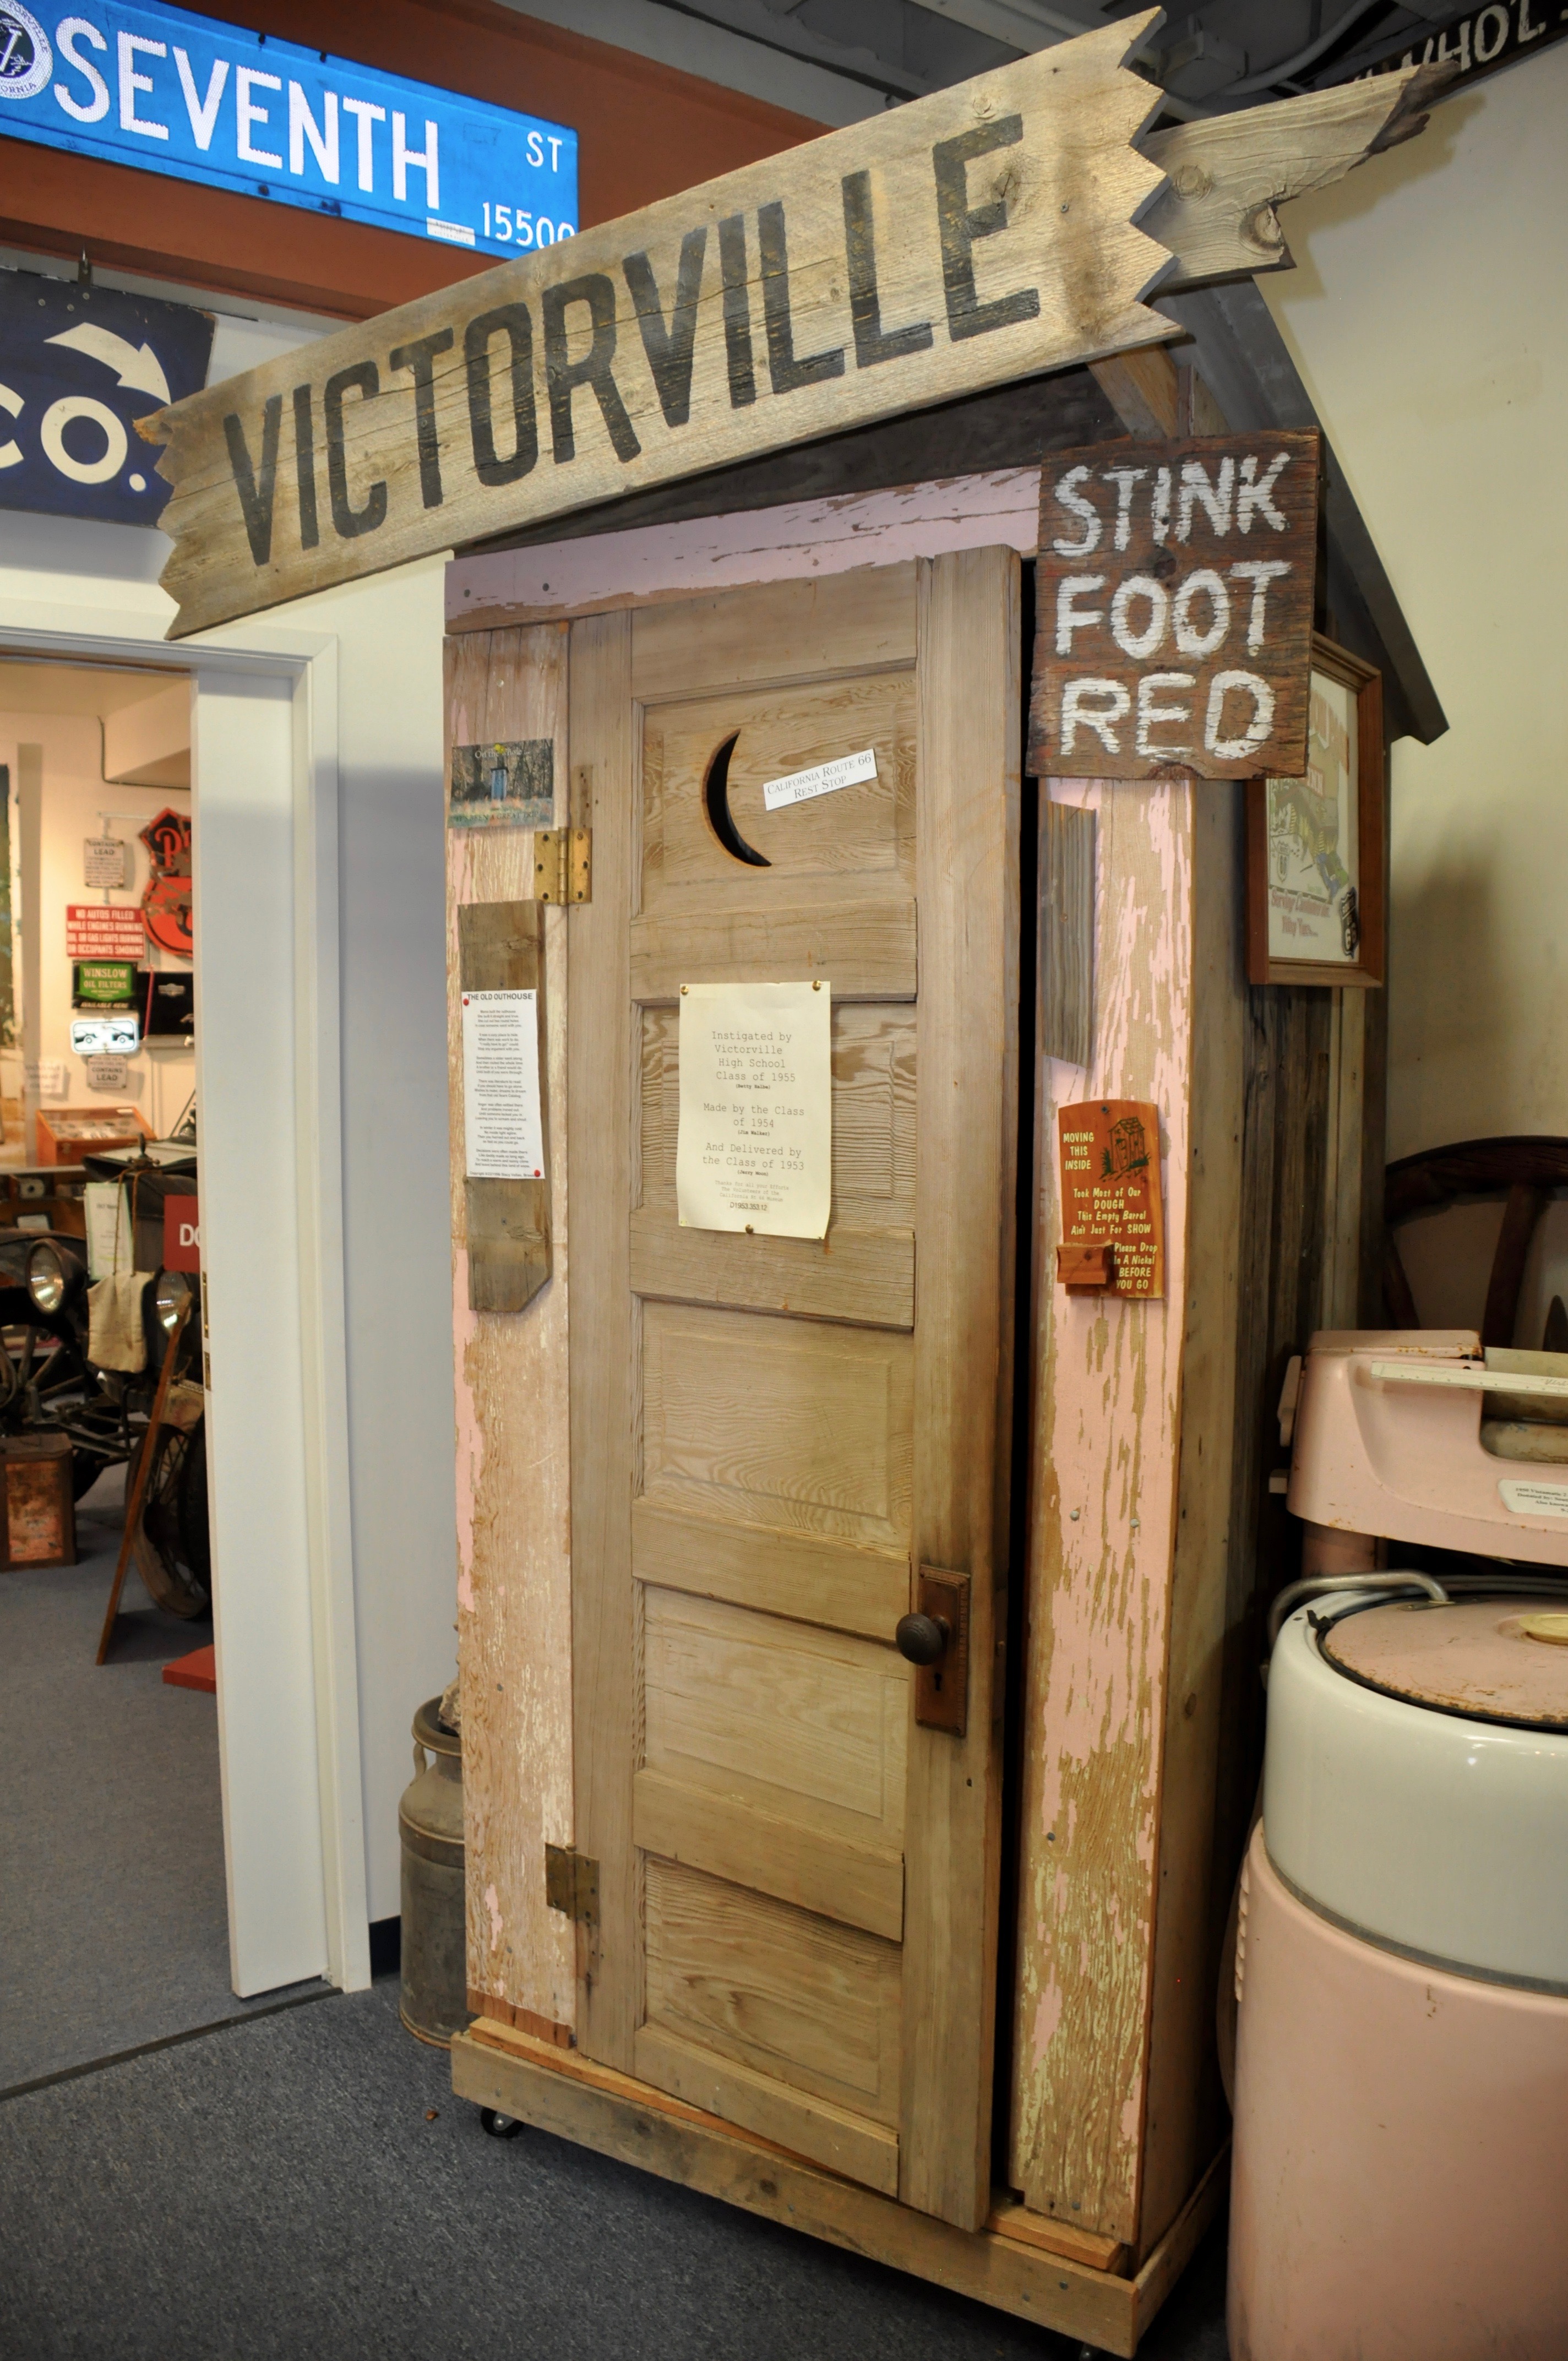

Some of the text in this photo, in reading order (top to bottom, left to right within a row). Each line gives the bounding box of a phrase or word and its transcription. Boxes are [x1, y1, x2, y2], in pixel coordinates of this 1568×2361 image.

[54, 17, 439, 210] SEVENTH
[526, 130, 563, 174] ST
[222, 114, 1041, 566] VICTORVILLE
[1053, 451, 1291, 557] STINK
[1056, 559, 1292, 659] FOOT
[1060, 670, 1275, 759] RED
[488, 749, 498, 757] the
[767, 753, 872, 795] CALIFORNIA ROUTE 66
[794, 775, 846, 798] REST STOP
[75, 909, 134, 920] NO AUTOS FILLED
[84, 968, 127, 978] WINSLOW
[712, 1031, 792, 1043] Instigated by
[715, 1045, 782, 1054] Victorville
[718, 1058, 786, 1068] High School
[716, 1071, 796, 1082] Class of 1955
[704, 1103, 804, 1116] Made by the Class
[733, 1118, 774, 1128] of 1954
[1063, 1132, 1095, 1144] MOVING
[706, 1143, 802, 1158] And Delivered by
[1070, 1145, 1088, 1156] THIS
[703, 1156, 804, 1170] the Class of 1953
[1065, 1160, 1092, 1170] INSIDE
[1073, 1187, 1142, 1198] Took Most of Our
[1094, 1199, 1125, 1210] DOUGH
[1077, 1210, 1146, 1223] This Empty Barrel
[1091, 1224, 1106, 1234] Just
[1109, 1224, 1122, 1234] For
[1127, 1223, 1151, 1234] SHOW
[1114, 1242, 1158, 1254] Please Drop
[1114, 1255, 1155, 1265] In A Nickel
[1119, 1267, 1151, 1277] BEFORE
[1116, 1279, 1149, 1289] YOU GO
